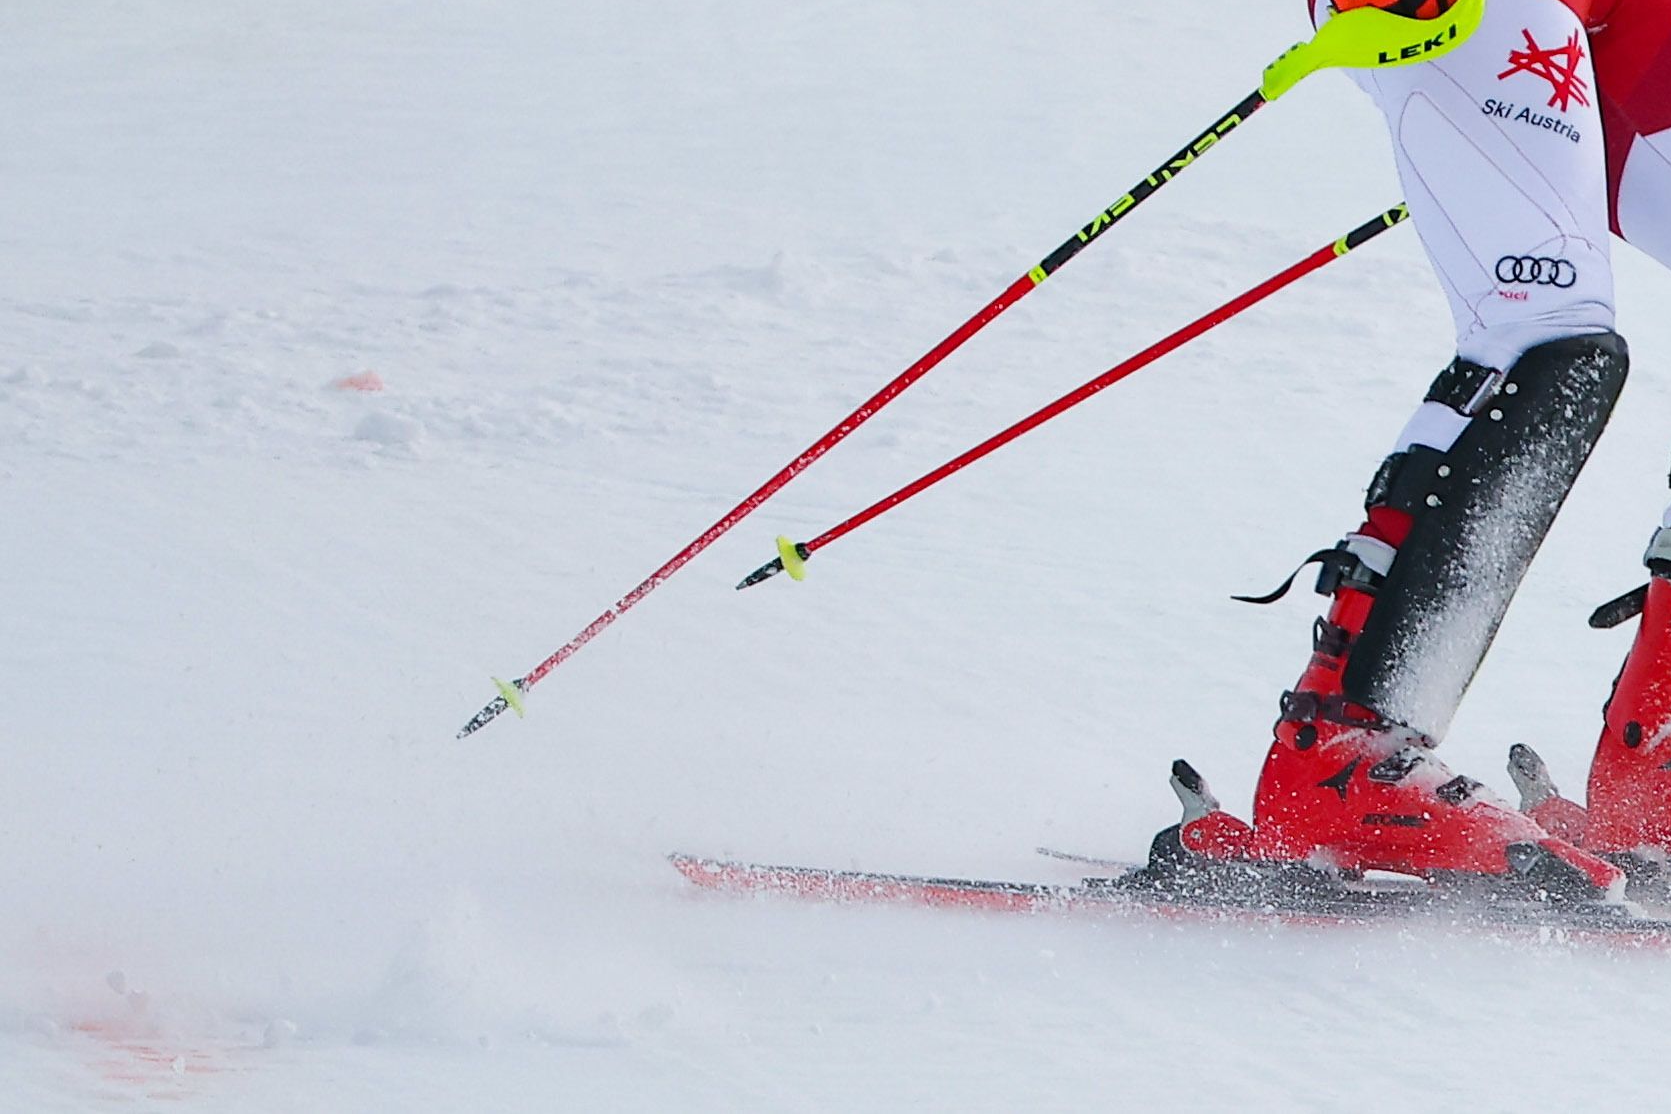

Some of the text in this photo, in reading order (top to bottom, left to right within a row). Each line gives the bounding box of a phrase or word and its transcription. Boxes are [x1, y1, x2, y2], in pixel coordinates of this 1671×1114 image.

[1378, 23, 1457, 64] LEKI
[1481, 98, 1581, 144] Ski Austria
